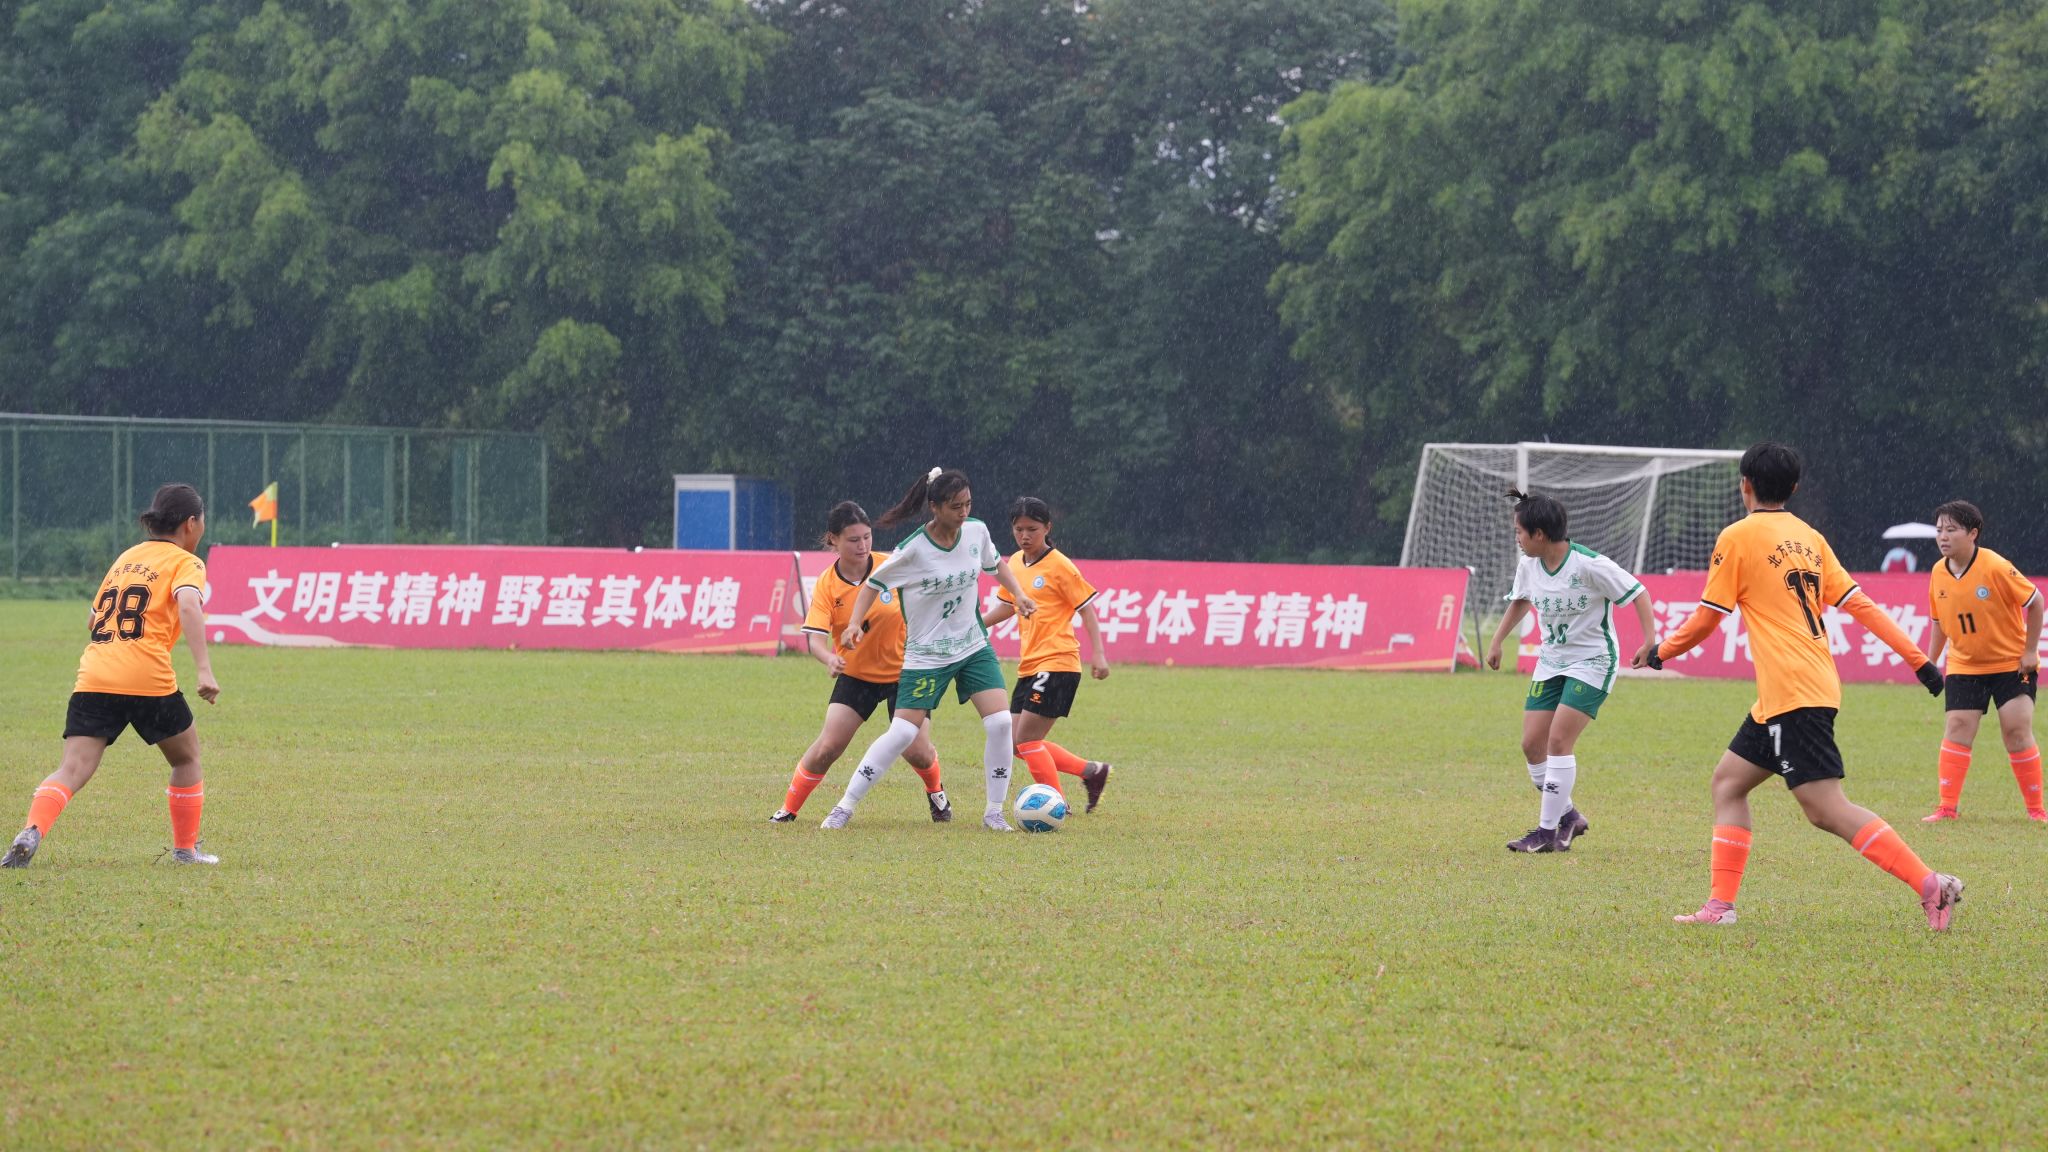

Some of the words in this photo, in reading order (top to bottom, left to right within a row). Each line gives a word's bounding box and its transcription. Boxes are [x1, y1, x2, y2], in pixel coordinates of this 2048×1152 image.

[1767, 540, 1822, 569] 北方民族大学
[241, 569, 486, 626] 文明其精神
[492, 573, 741, 630] 野蛮其体魄
[91, 584, 152, 644] 28
[1957, 612, 1977, 635] 11
[1546, 623, 1569, 645] 10
[911, 677, 936, 698] 21
[1032, 671, 1050, 693] 2
[1768, 723, 1782, 757] 7
